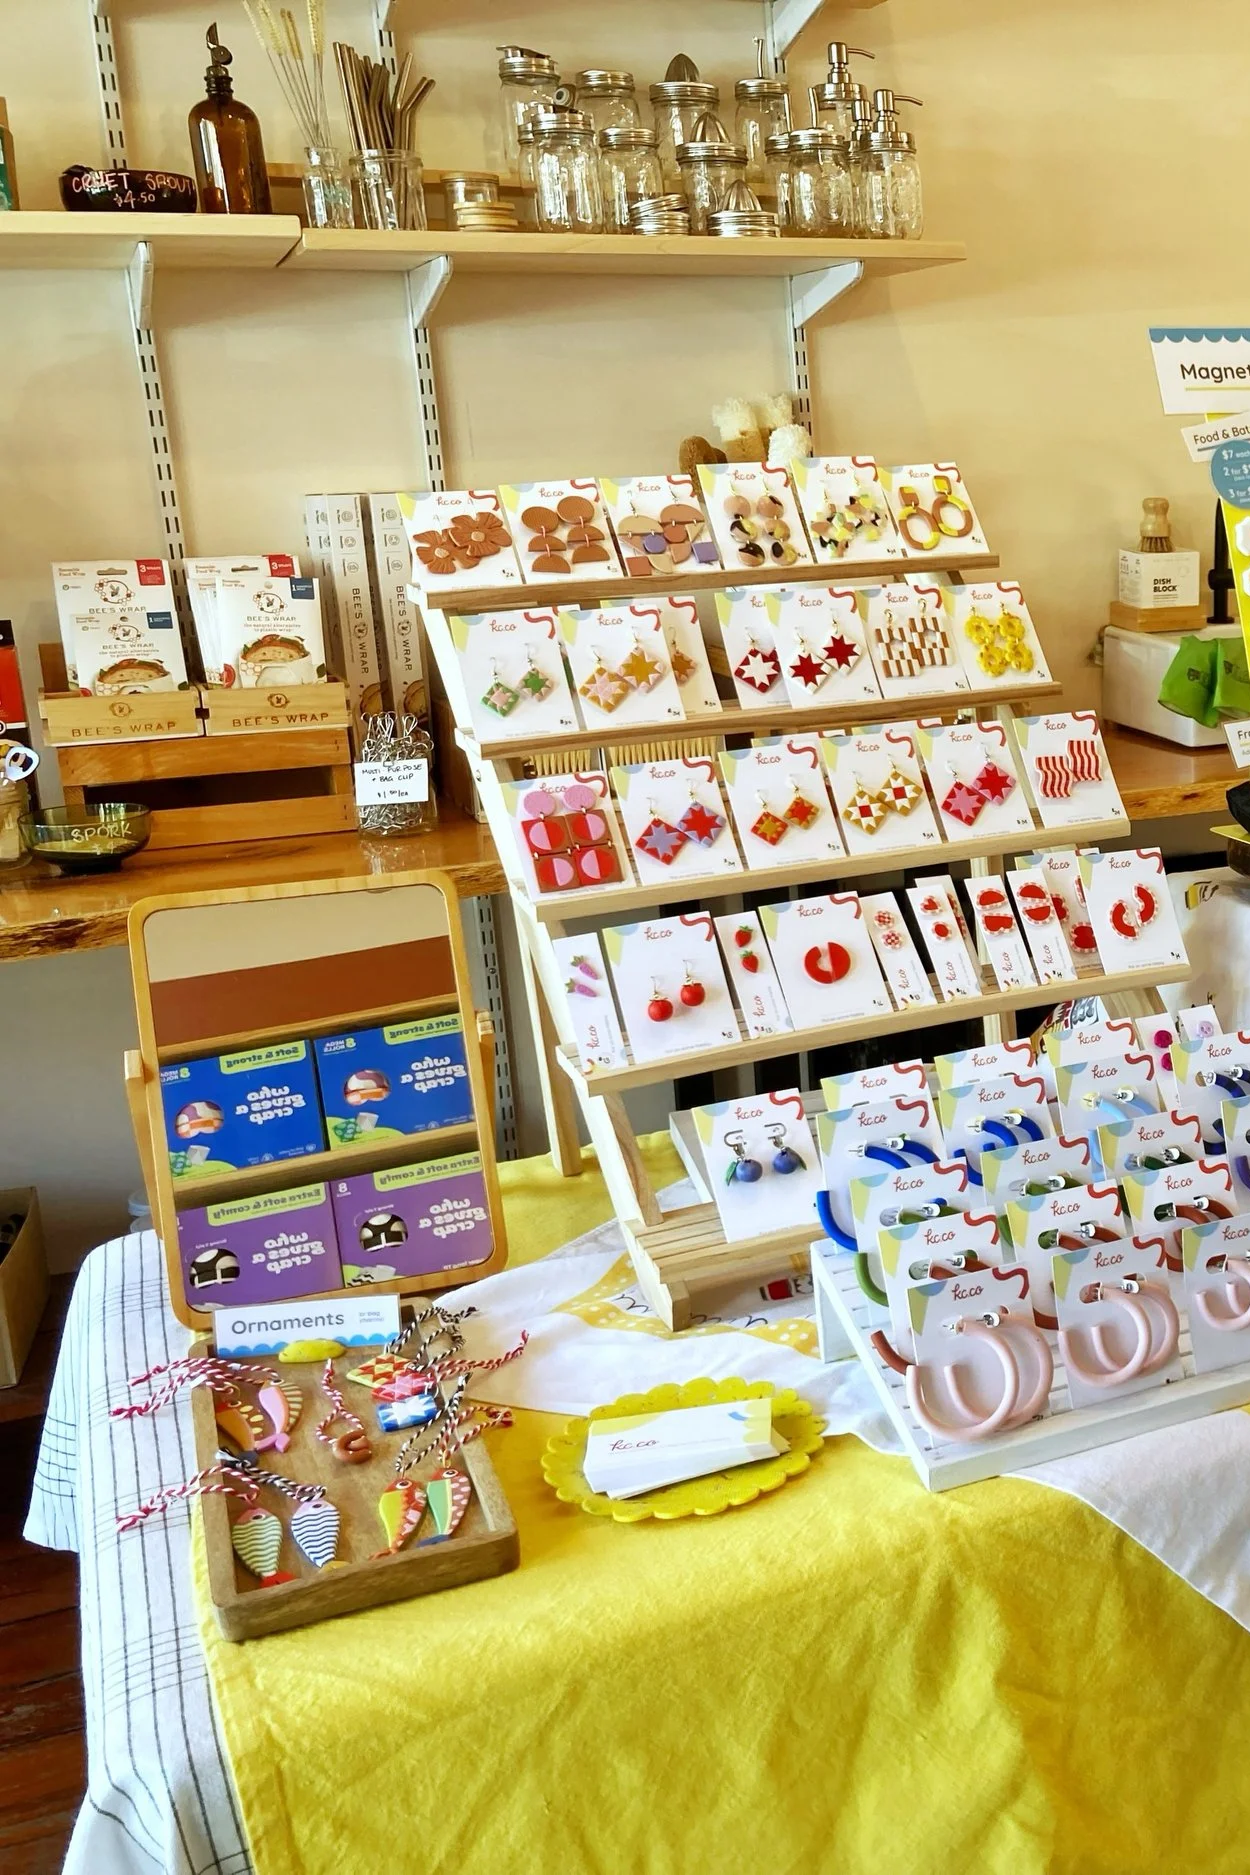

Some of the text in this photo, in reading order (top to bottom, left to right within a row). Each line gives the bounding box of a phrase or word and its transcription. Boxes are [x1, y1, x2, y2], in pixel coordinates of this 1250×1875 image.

[1194, 431, 1219, 444] Food
[1222, 429, 1230, 439] &
[1222, 449, 1233, 460] $7
[1223, 467, 1230, 476] 2
[1228, 489, 1235, 498] 3
[352, 588, 369, 674] BEE'S WRAP
[396, 585, 412, 671] BEE'S WRAP
[232, 713, 329, 728] BEE'S WRAP
[72, 721, 176, 737] BEE'S WRAP
[71, 821, 132, 843] SPORK
[231, 1313, 344, 1335] Ornaments
